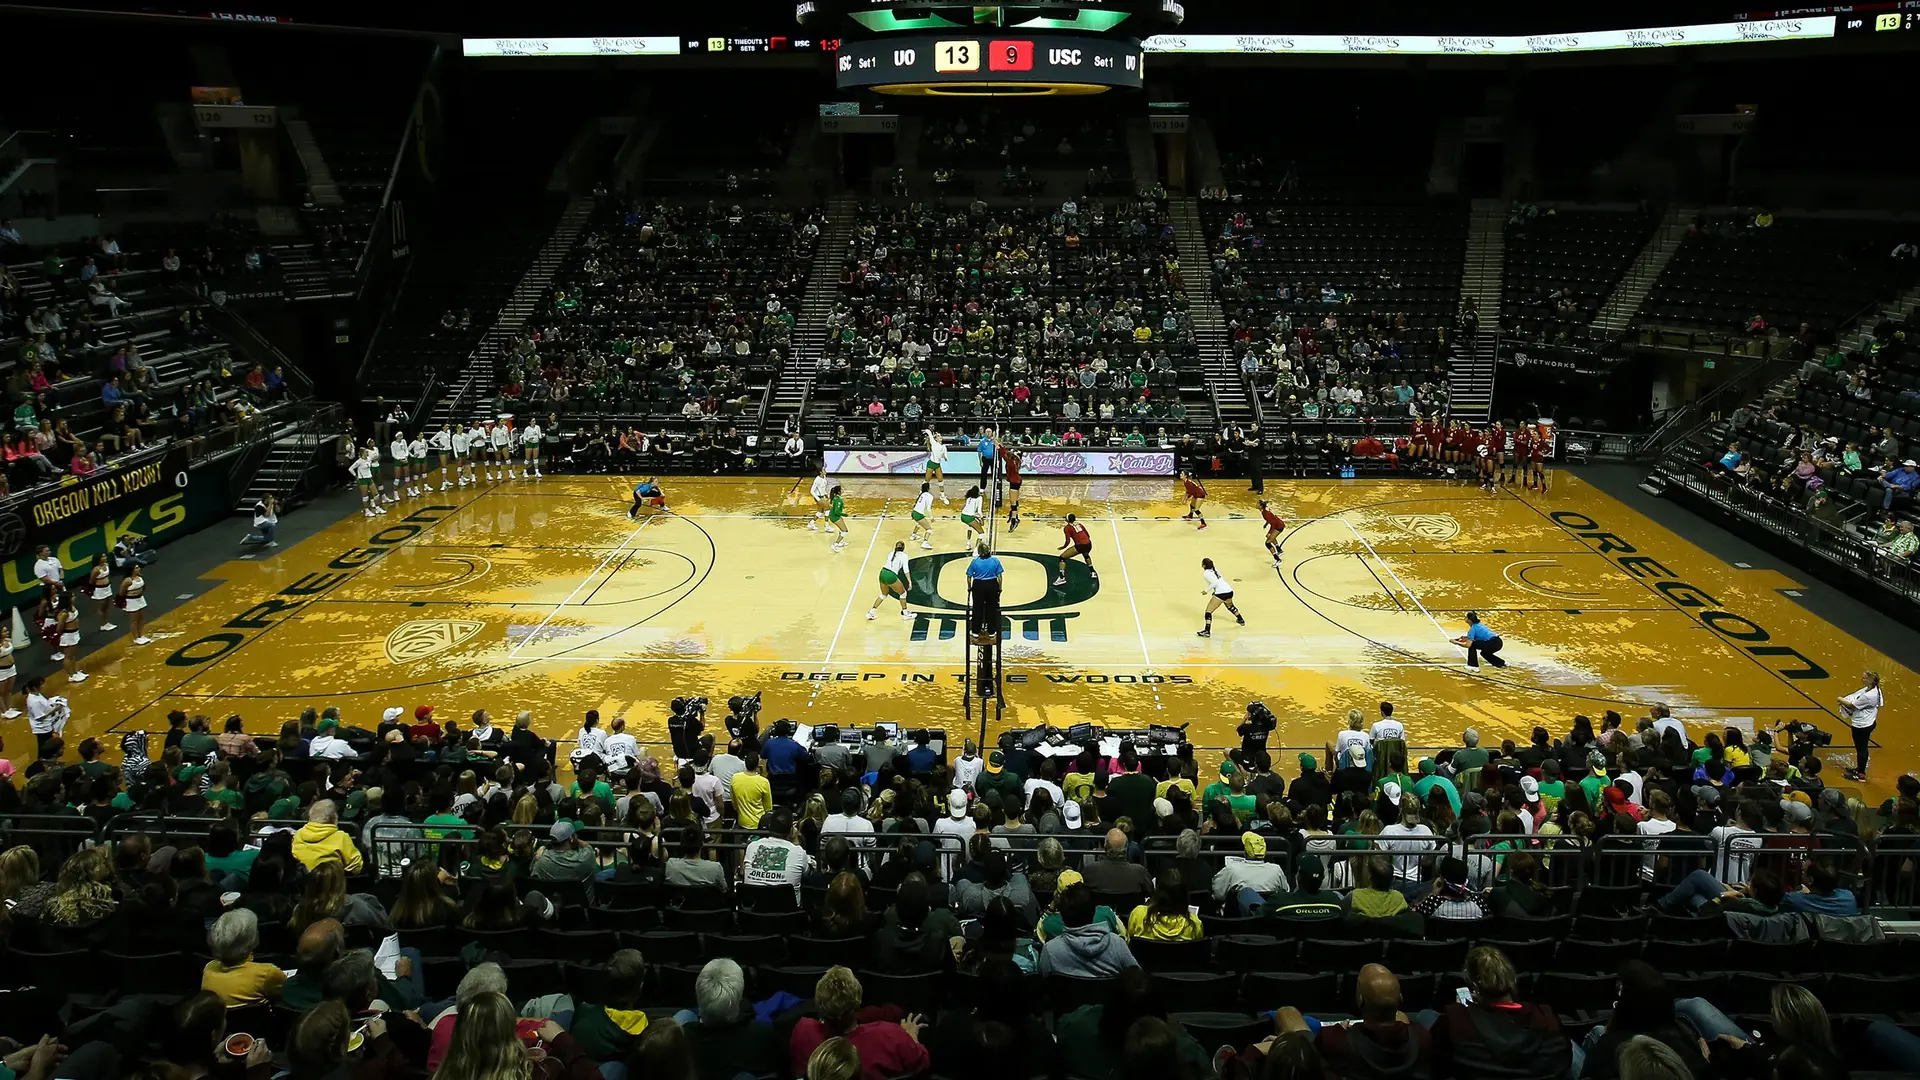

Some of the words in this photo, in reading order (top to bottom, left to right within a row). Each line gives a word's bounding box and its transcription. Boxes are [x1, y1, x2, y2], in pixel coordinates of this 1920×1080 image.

[1881, 16, 1896, 27] 13
[711, 41, 723, 49] 13
[858, 58, 870, 69] Set
[871, 56, 876, 68] 1
[893, 49, 916, 66] UO
[945, 46, 969, 64] 13
[1006, 45, 1018, 64] 9
[1049, 49, 1082, 66] USC
[1094, 55, 1108, 68] Set
[1109, 56, 1114, 68] 1
[1125, 54, 1136, 71] UO
[227, 291, 284, 300] NETWORKS
[1527, 358, 1576, 369] NETWORKS
[33, 487, 90, 527] OREGON
[91, 479, 121, 506] KILL
[165, 505, 456, 667] OREGON
[1550, 511, 1829, 679] OREGON
[781, 672, 886, 682] DEEP
[902, 673, 935, 682] IN
[951, 673, 1028, 683] TE
[1045, 674, 1193, 684] WOODS
[750, 870, 783, 880] OREGON
